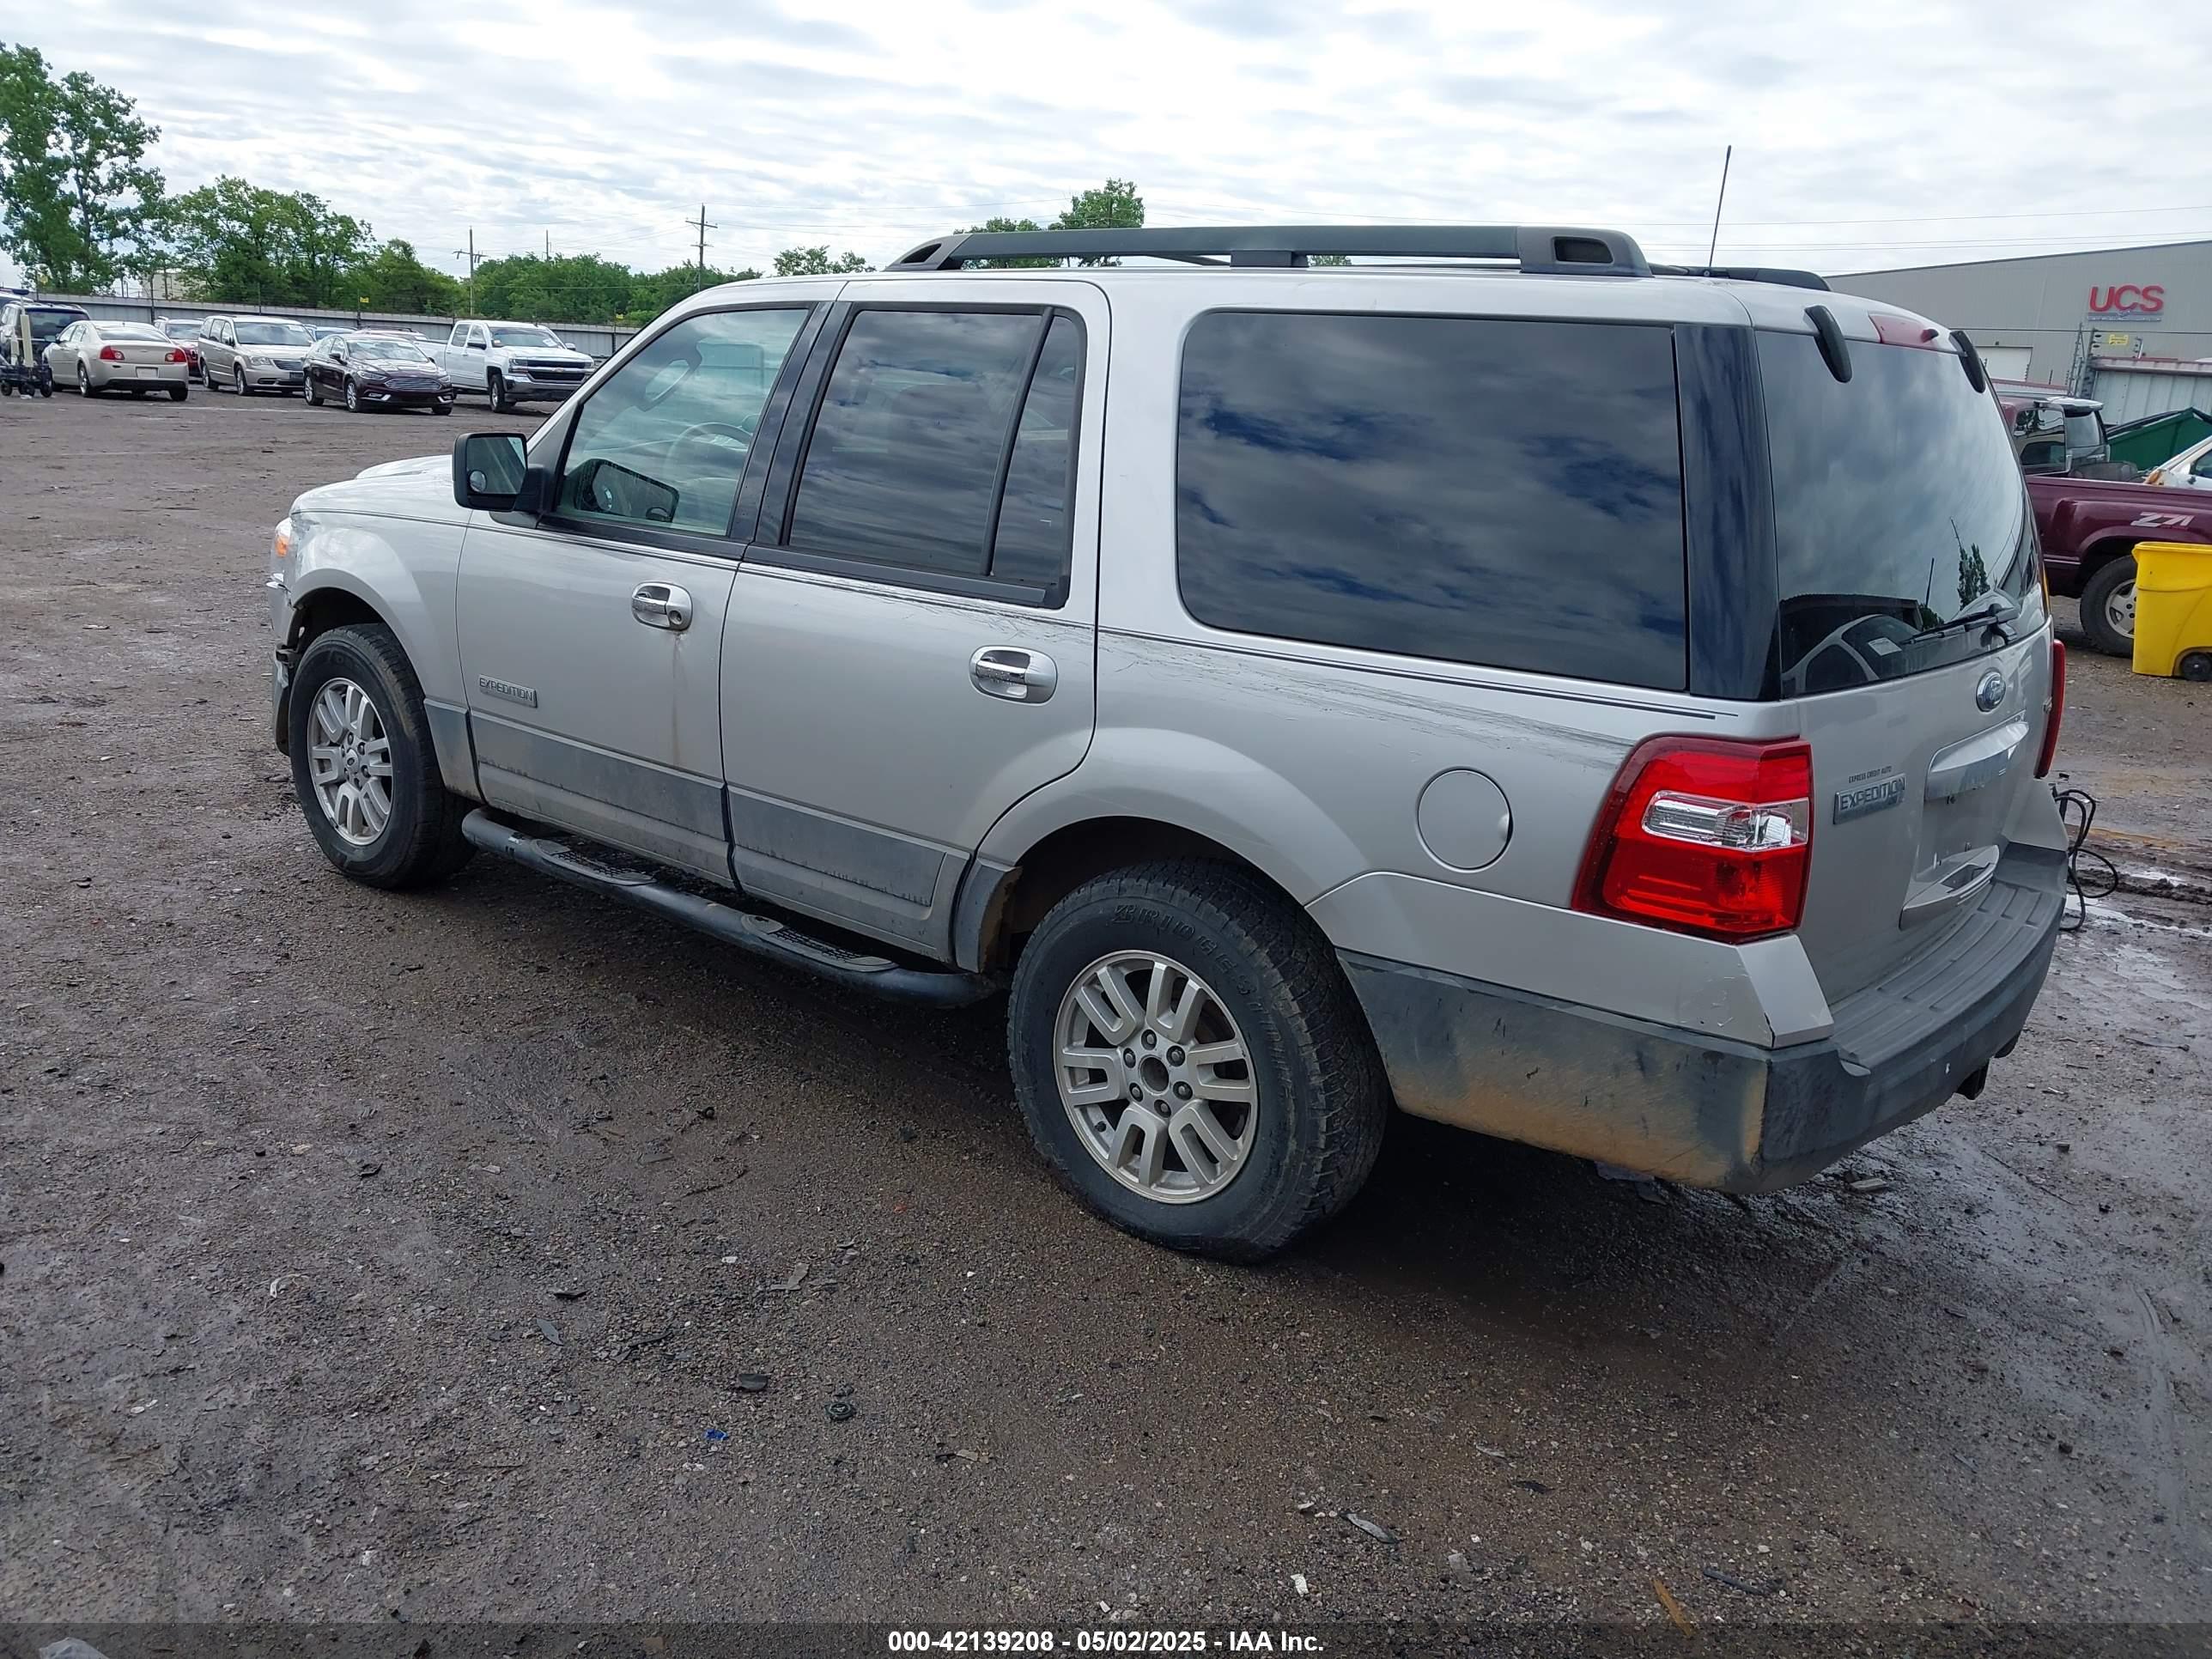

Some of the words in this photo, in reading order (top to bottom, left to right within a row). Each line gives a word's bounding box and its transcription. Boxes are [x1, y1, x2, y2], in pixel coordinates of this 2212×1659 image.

[2089, 285, 2164, 312] UCS
[2130, 512, 2195, 527] Z71
[479, 678, 533, 702] EXPEDITION
[1840, 775, 1906, 811] EXPEDITION
